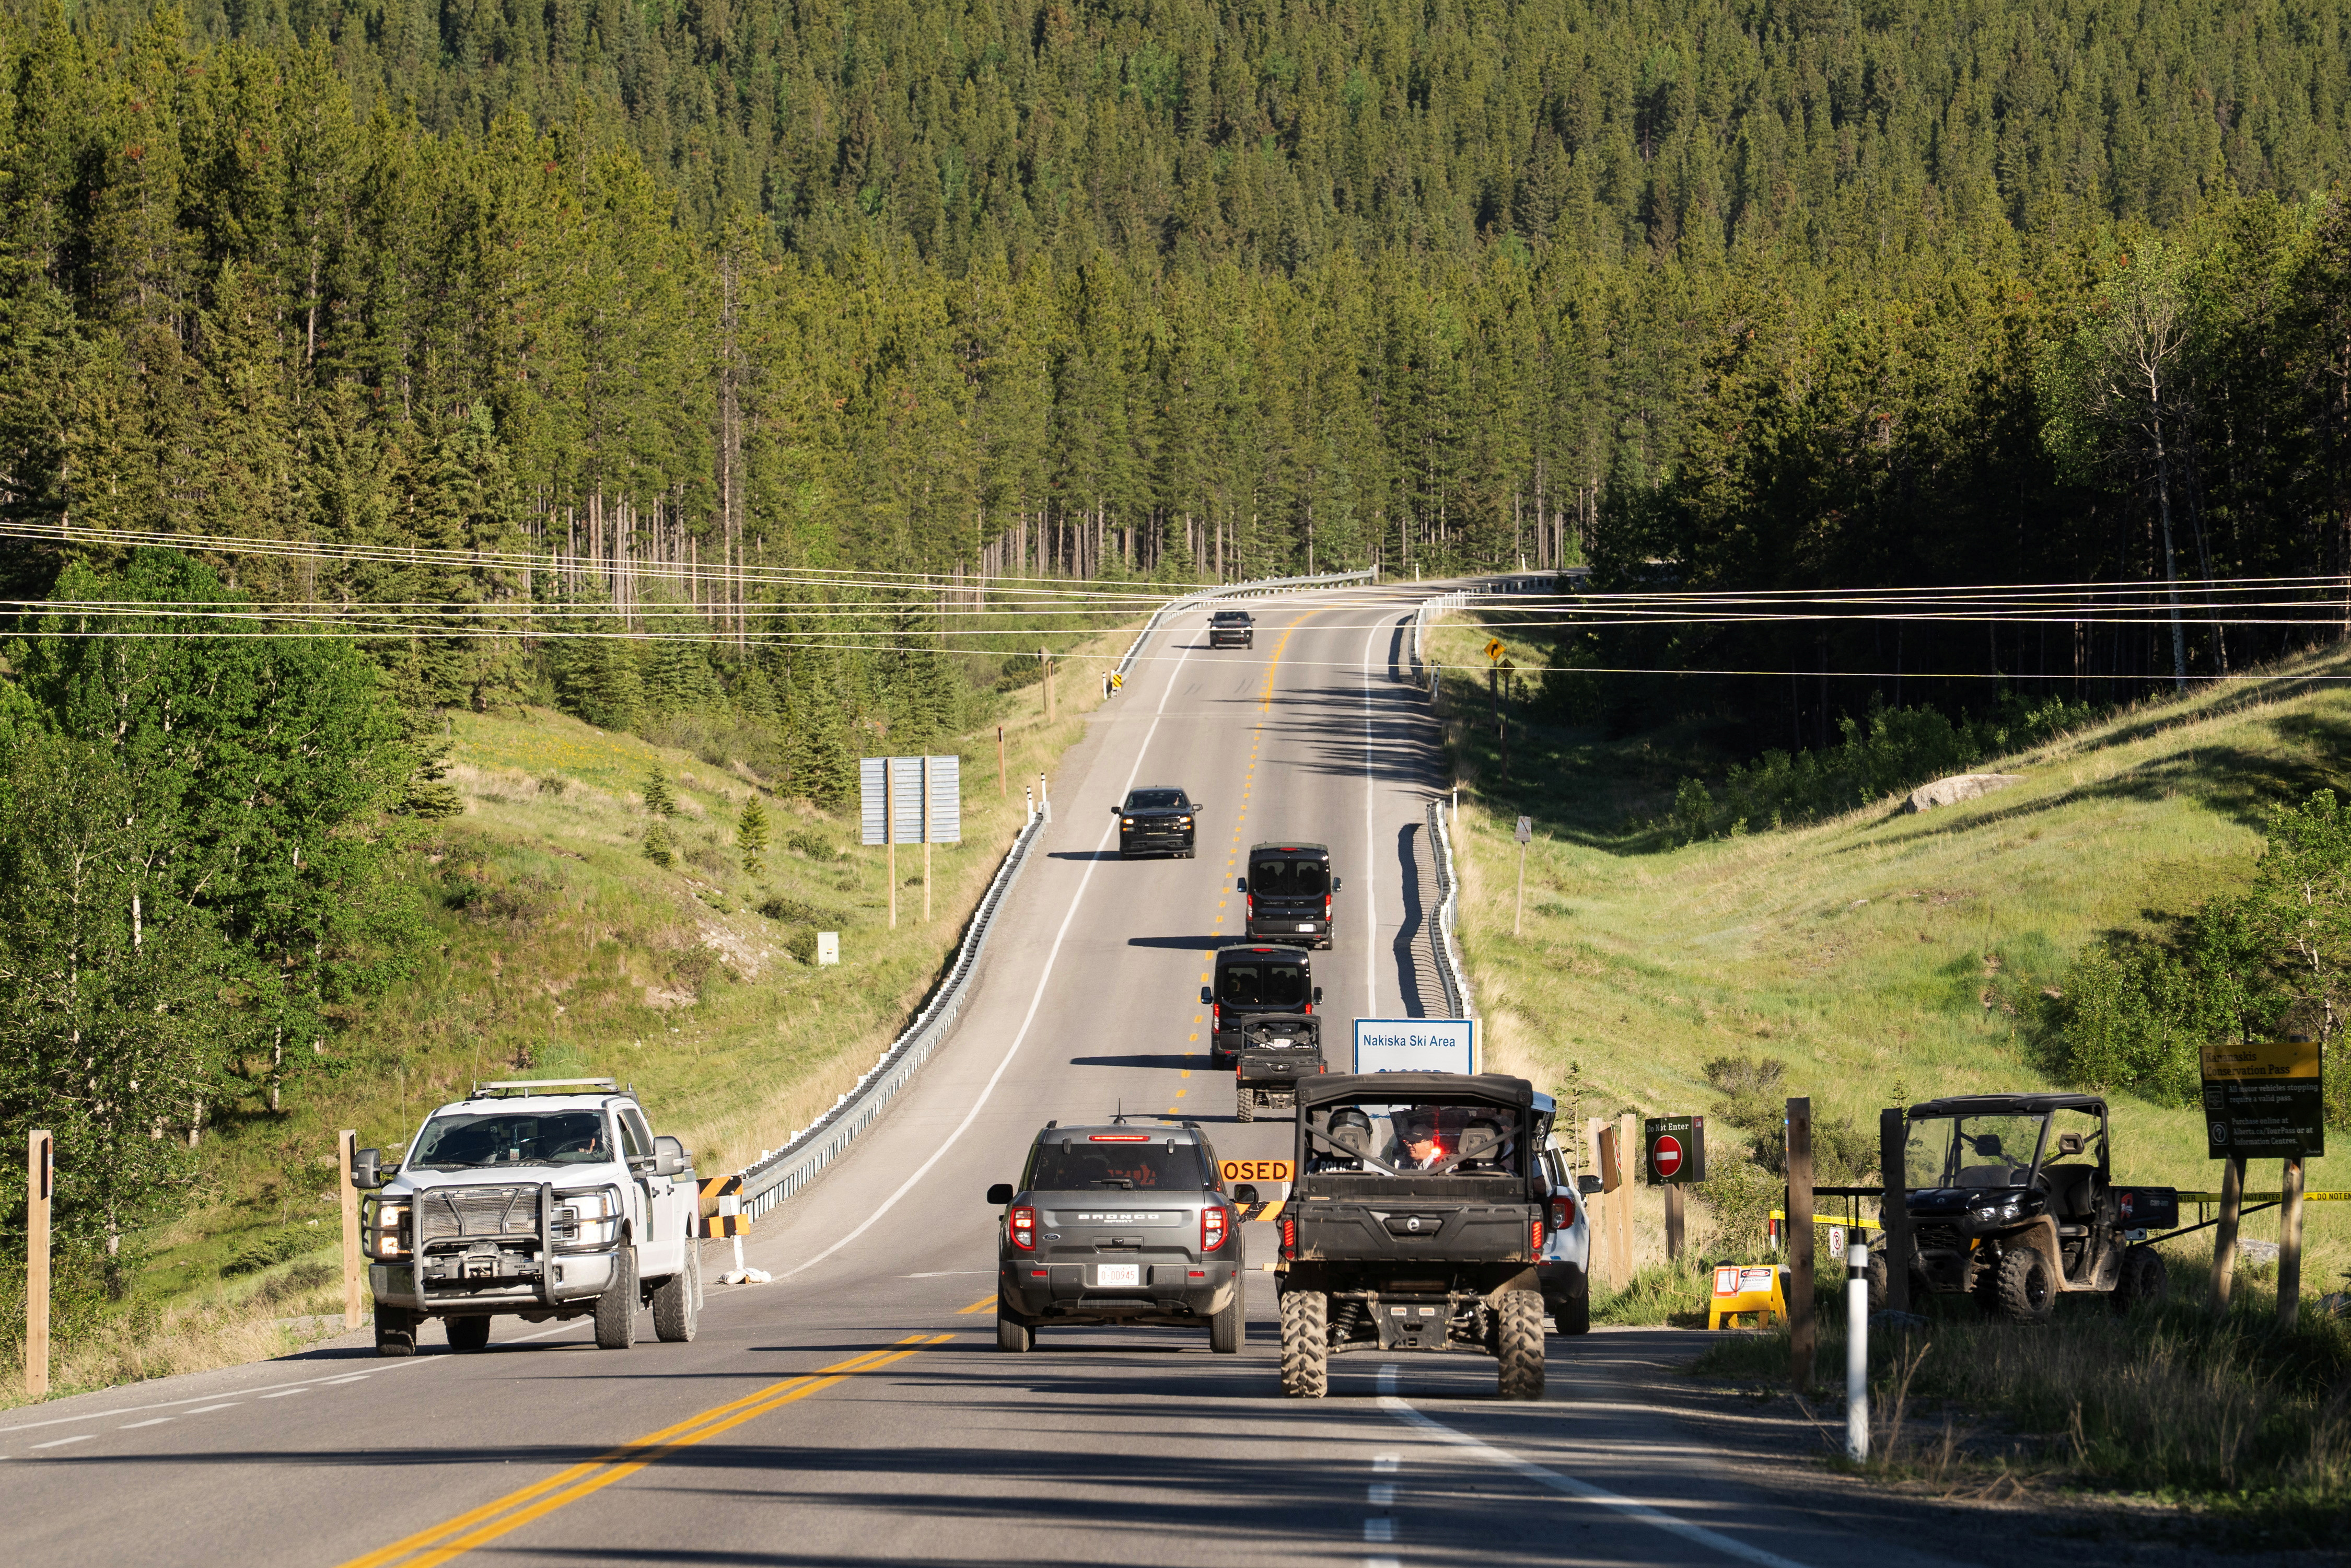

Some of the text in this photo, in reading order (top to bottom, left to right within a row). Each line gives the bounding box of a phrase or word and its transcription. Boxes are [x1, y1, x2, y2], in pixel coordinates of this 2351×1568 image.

[1364, 1035, 1456, 1047] Nakiska Ski Area
[2205, 1051, 2256, 1062] Kananaskis
[2207, 1064, 2290, 1076] Conservation Pass
[2287, 1084, 2318, 1092] stopping
[2233, 1127, 2295, 1135] Alberta.ca/YourPass
[1224, 1162, 1287, 1180] OSED
